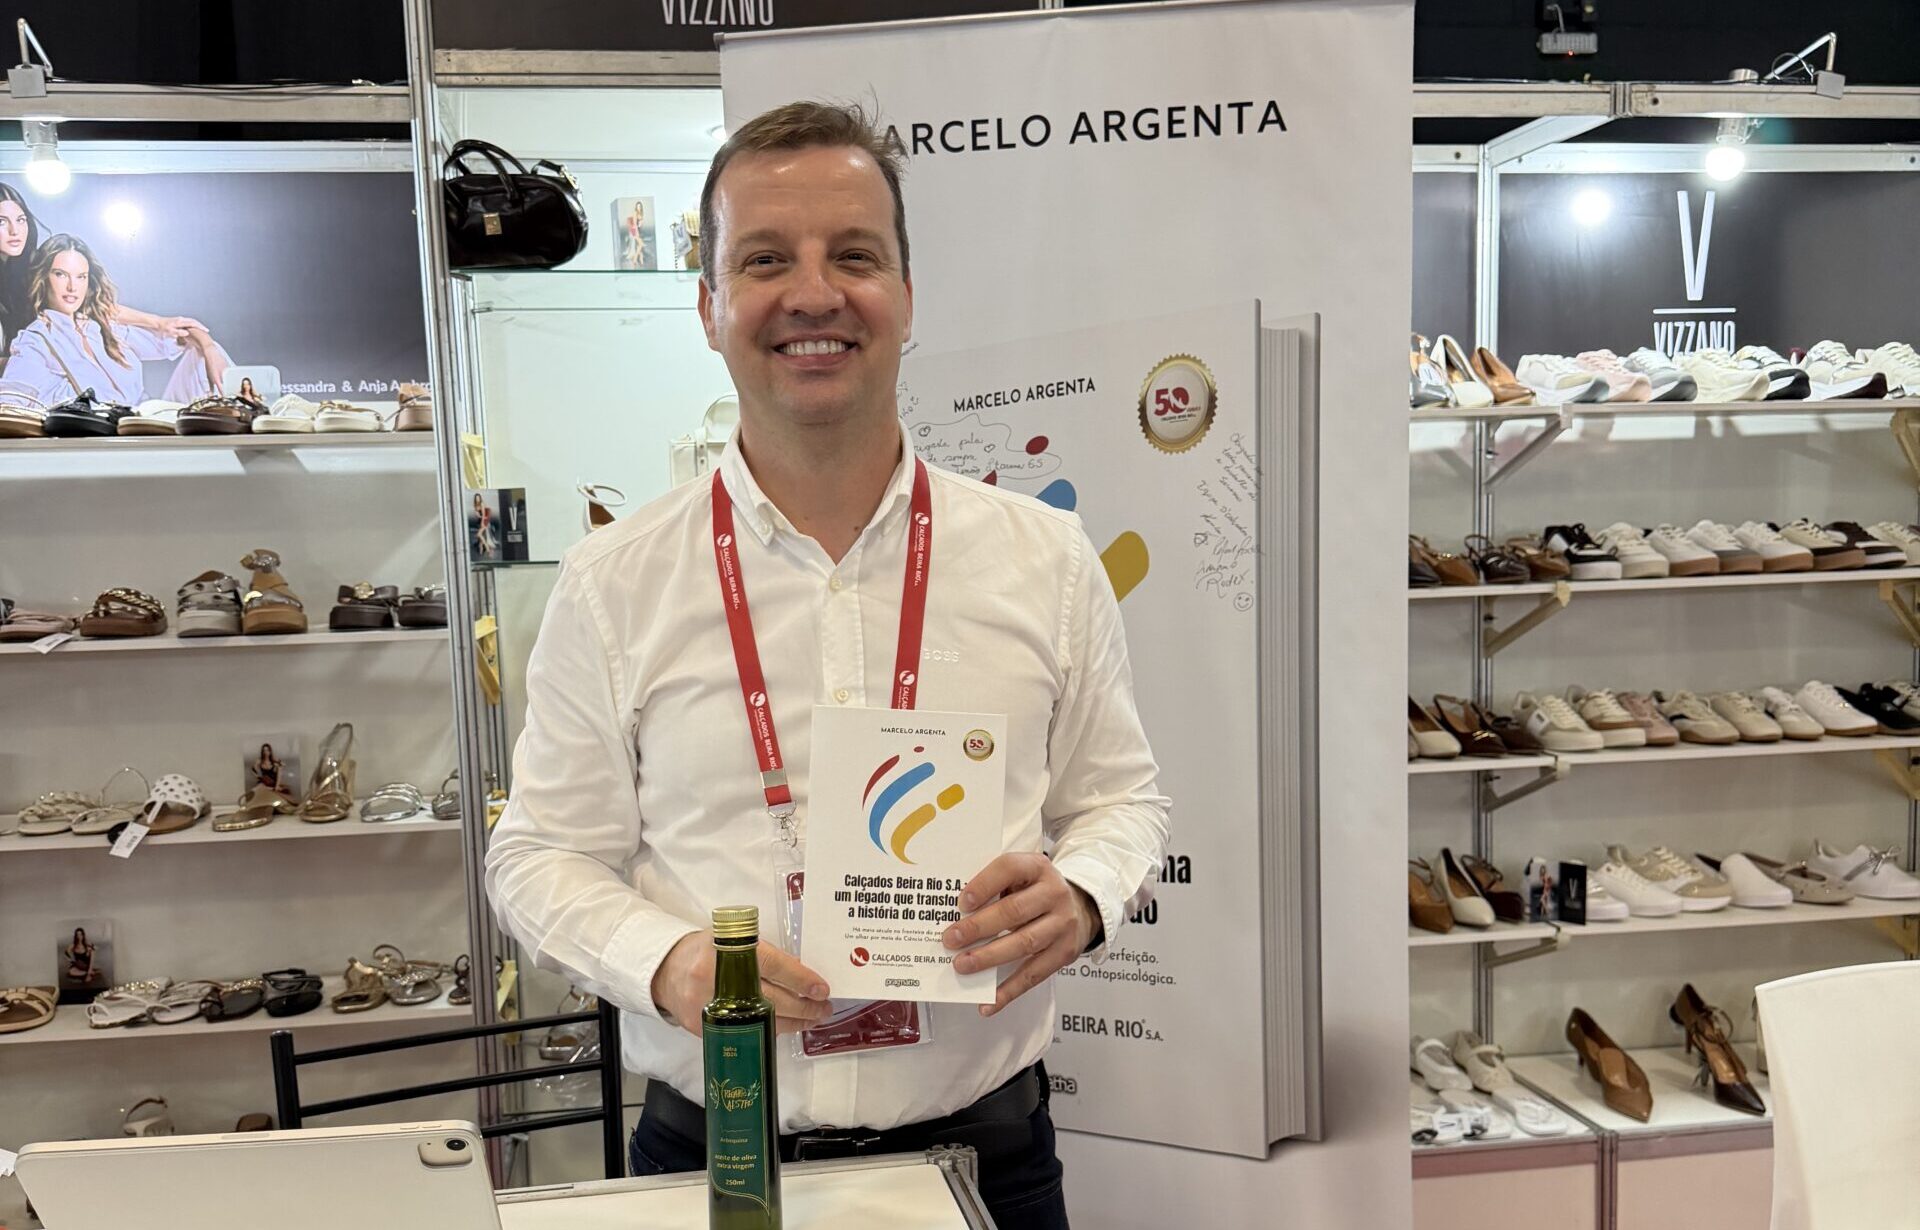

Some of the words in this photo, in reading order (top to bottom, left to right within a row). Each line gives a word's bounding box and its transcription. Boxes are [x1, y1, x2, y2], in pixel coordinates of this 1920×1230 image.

[886, 113, 1051, 155] ARCELO
[1069, 100, 1288, 145] ARGENTA
[1676, 190, 1716, 301] V
[1653, 320, 1737, 357] VIZZANO
[282, 380, 336, 393] essandra
[341, 380, 354, 393] &
[358, 380, 388, 394] Anja
[953, 388, 1022, 414] MARCELO
[1025, 376, 1097, 402] ARGENTA
[1153, 386, 1190, 417] 50
[914, 728, 947, 736] ARGENTA
[844, 874, 893, 891] Calçados
[896, 876, 924, 890] Beira
[926, 877, 943, 891] Rio
[834, 890, 852, 902] um
[854, 890, 891, 905] legado
[893, 892, 914, 906] que
[916, 892, 959, 907] transfor
[848, 907, 855, 918] a
[857, 905, 899, 920] história
[902, 907, 915, 920] do
[872, 953, 912, 963] CALÇADOS
[914, 955, 936, 964] BEIRA
[1109, 947, 1159, 965] erfeição.
[1079, 964, 1177, 986] Ontopsicológica.
[1061, 1013, 1109, 1036] BEIRA
[1145, 1029, 1164, 1042] S.A.
[725, 1178, 746, 1186] 250ml
